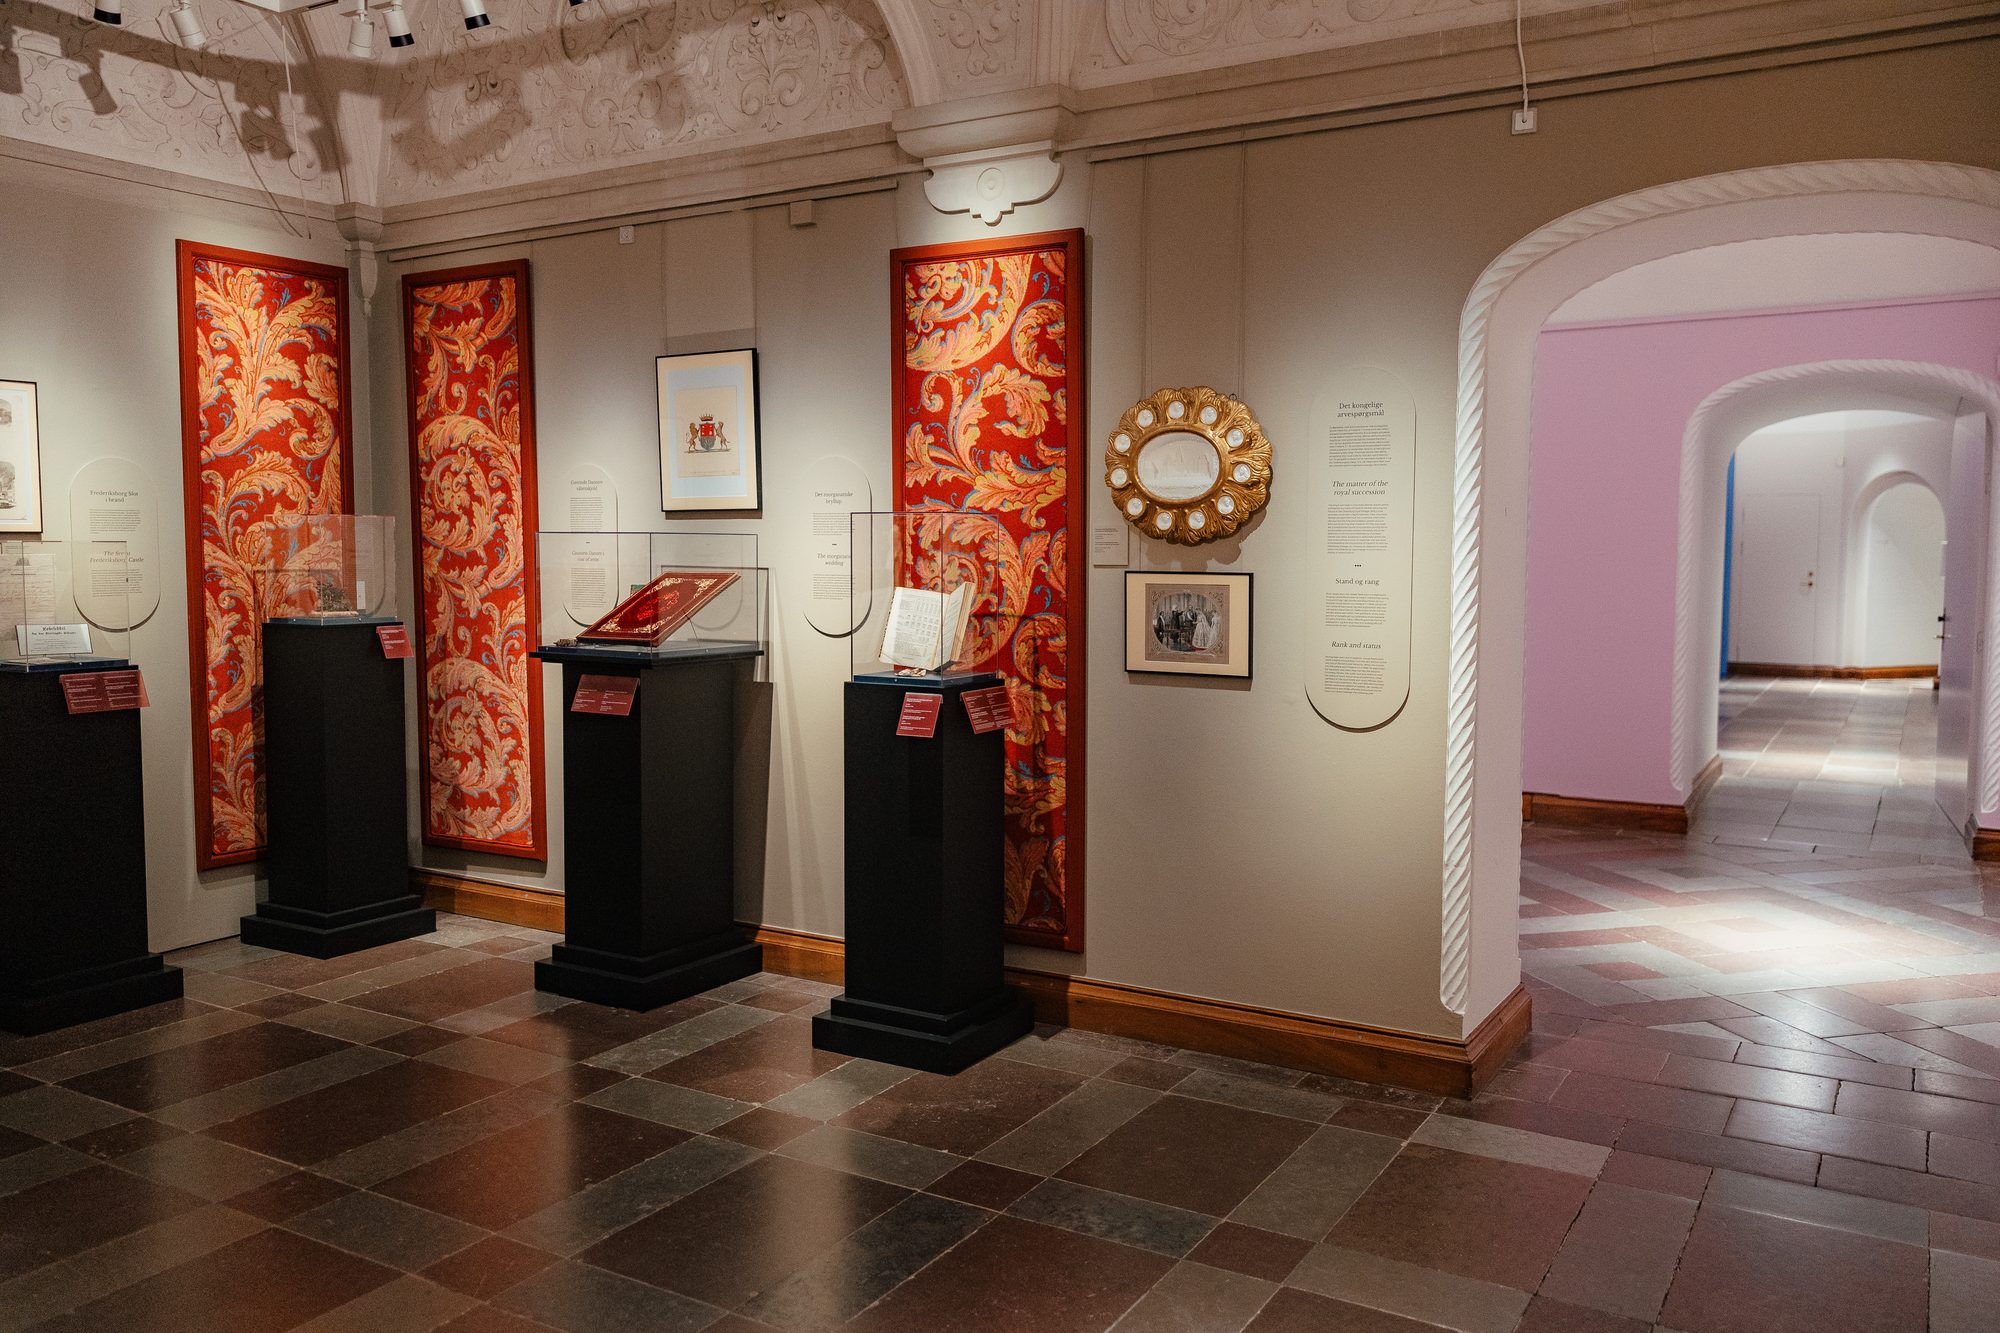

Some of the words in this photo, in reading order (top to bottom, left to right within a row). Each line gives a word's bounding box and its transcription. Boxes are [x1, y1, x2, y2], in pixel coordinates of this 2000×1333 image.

[1339, 402, 1351, 410] Det
[1352, 401, 1384, 410] kongelige
[1337, 409, 1385, 419] arvespørgsmål
[1333, 480, 1345, 488] The
[1346, 480, 1367, 488] matter
[1368, 479, 1377, 488] of
[1377, 479, 1389, 487] the
[1335, 577, 1354, 585] Stand
[1331, 640, 1348, 648] Rank
[1348, 641, 1362, 649] and
